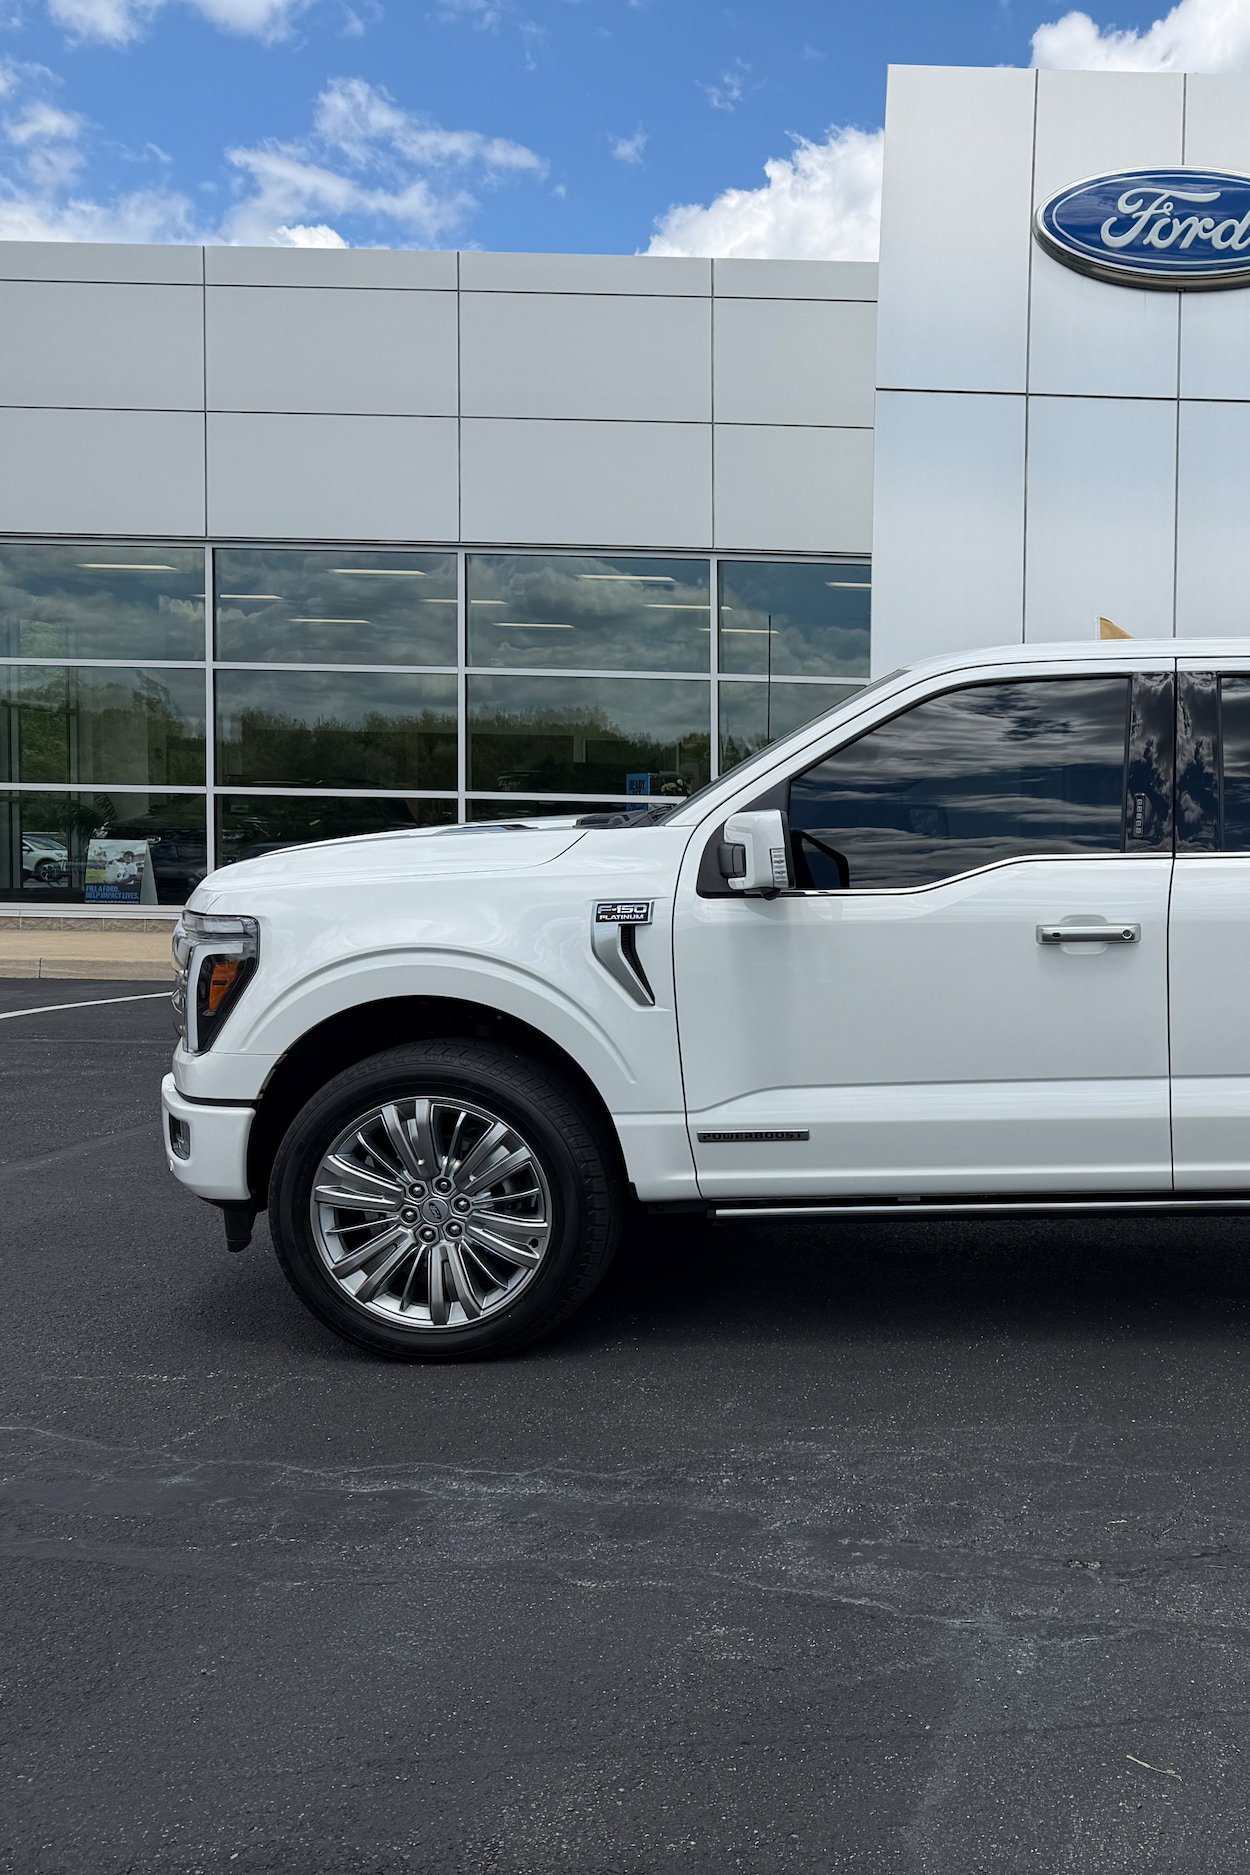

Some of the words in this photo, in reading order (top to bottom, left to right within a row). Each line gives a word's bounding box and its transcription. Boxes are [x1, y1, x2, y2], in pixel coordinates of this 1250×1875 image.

[597, 903, 648, 914] F-150
[599, 913, 645, 921] PLATINUM
[700, 1131, 802, 1140] POWERBOOST
